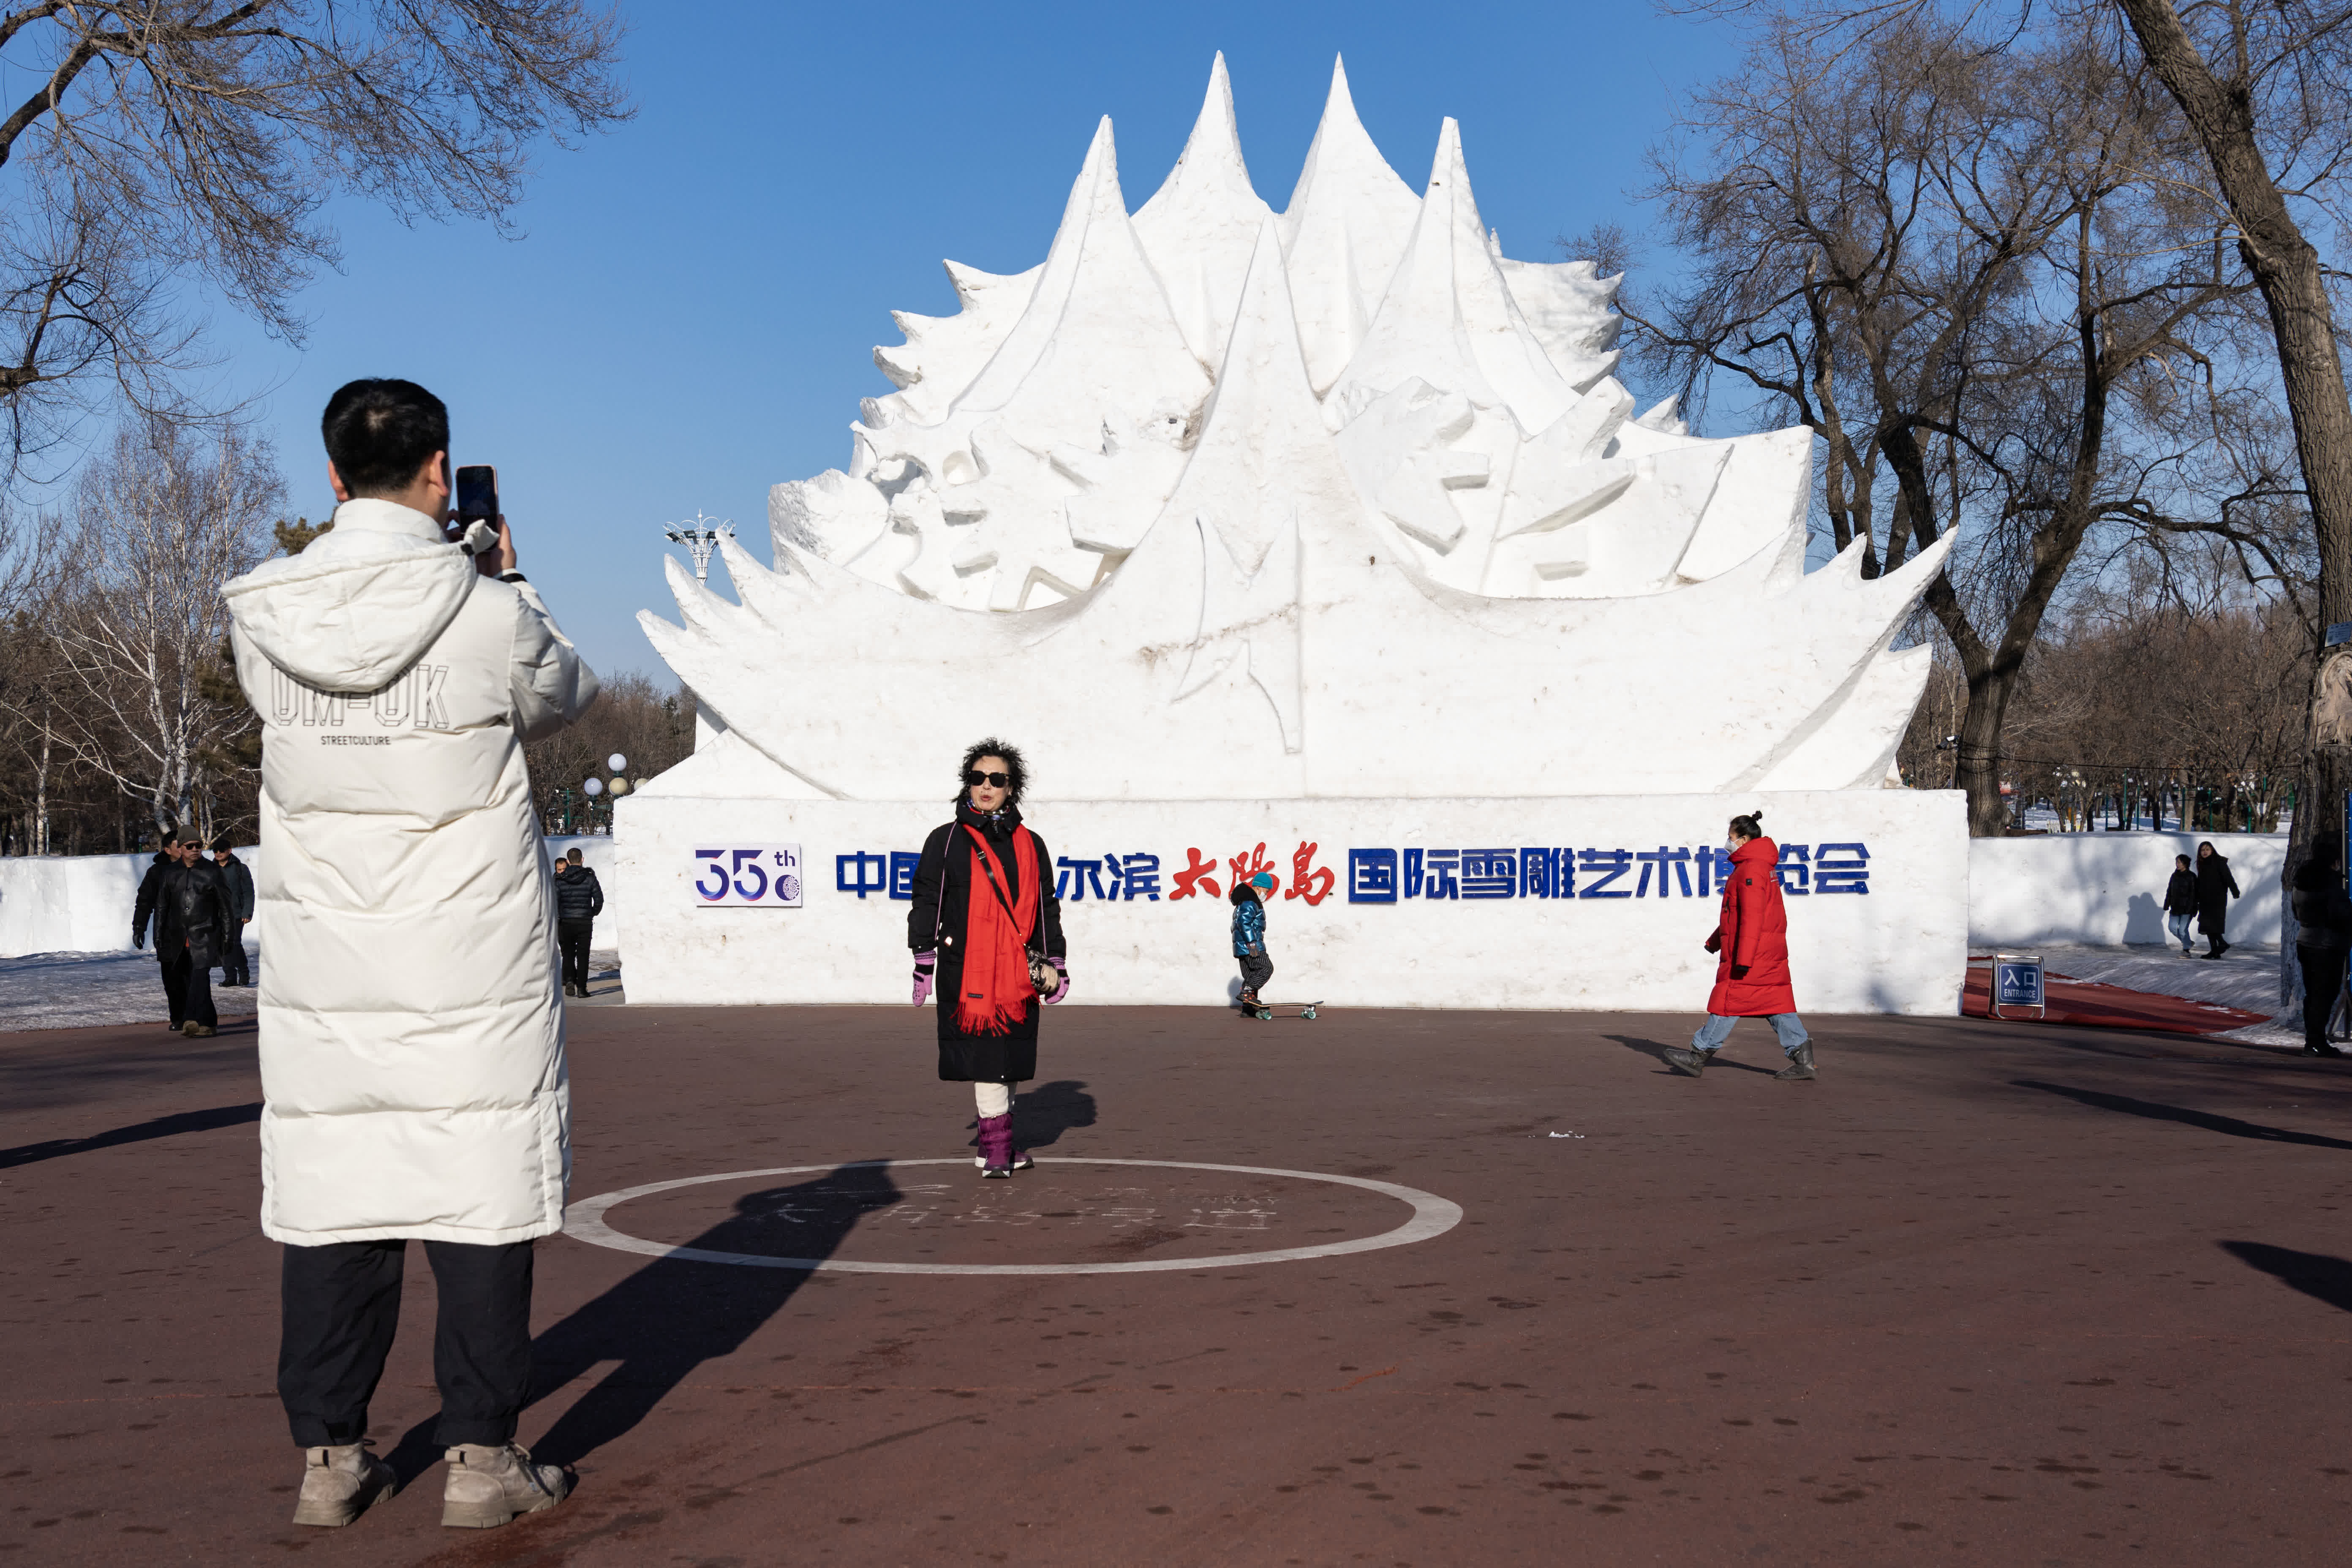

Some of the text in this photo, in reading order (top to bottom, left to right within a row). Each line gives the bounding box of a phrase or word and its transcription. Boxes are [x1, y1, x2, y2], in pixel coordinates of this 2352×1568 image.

[321, 736, 391, 746] STREETCULTURE
[2004, 969, 2036, 987] 入口
[2004, 988, 2036, 998] ENTRANCE
